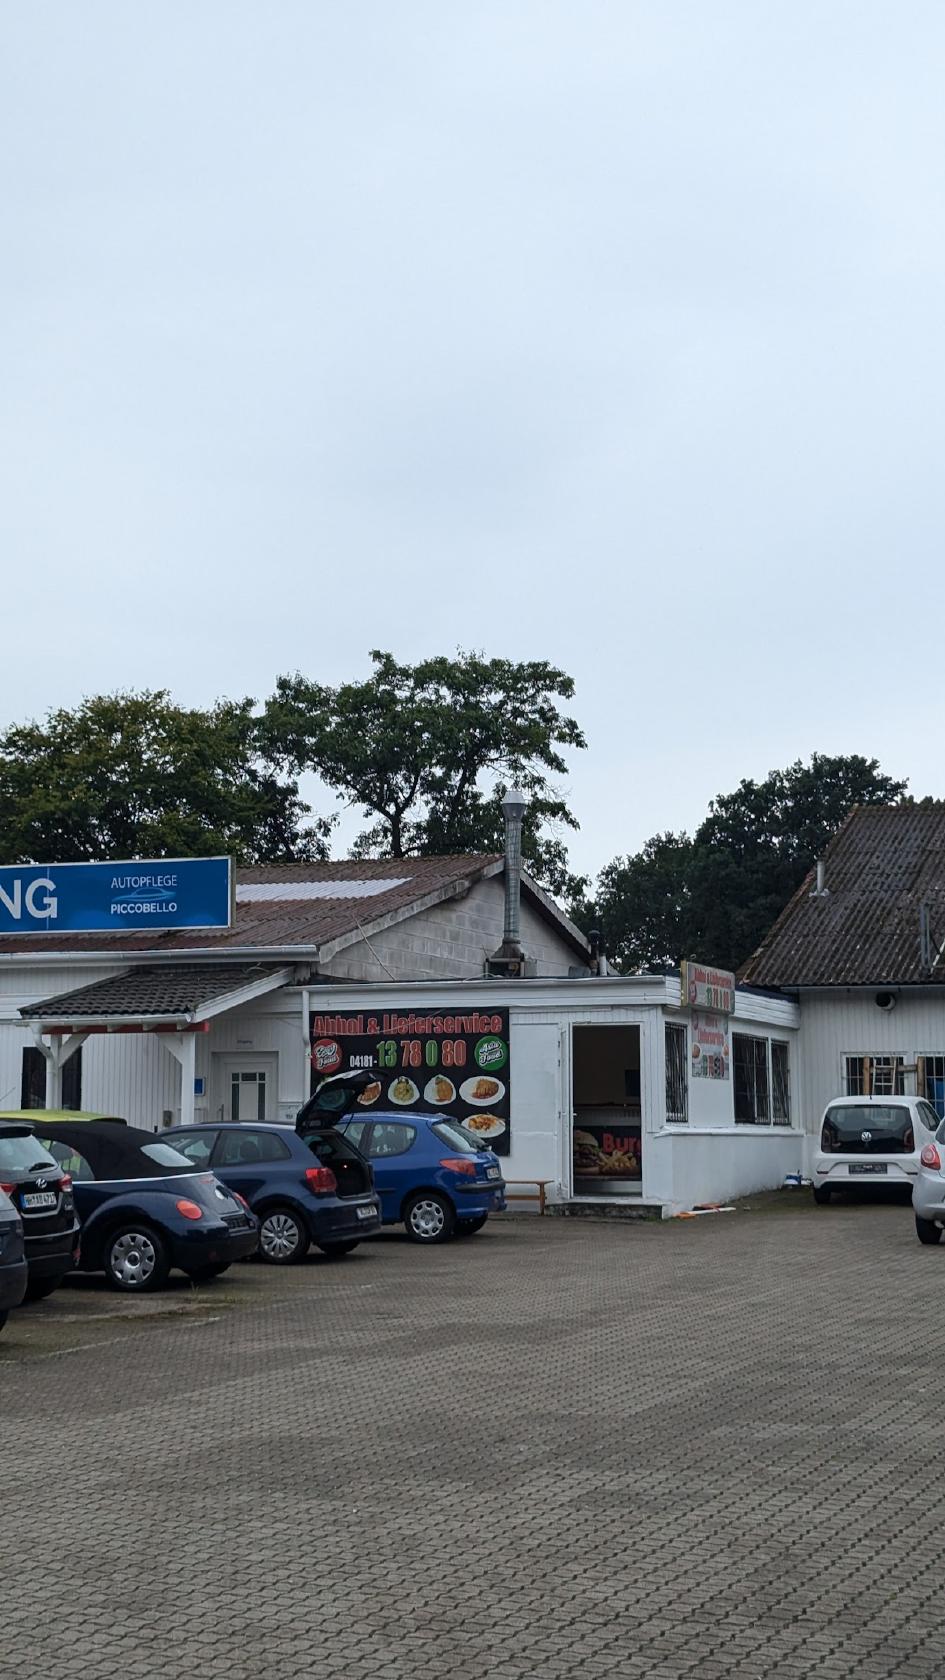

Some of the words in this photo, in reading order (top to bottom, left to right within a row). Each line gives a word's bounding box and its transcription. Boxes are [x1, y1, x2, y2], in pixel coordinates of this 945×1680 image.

[111, 875, 177, 888] AUTOPFLEGE
[110, 902, 177, 914] PICCOBELLO
[313, 1014, 363, 1036] Abhol
[367, 1017, 379, 1034] &
[383, 1013, 502, 1034] Lieferservice
